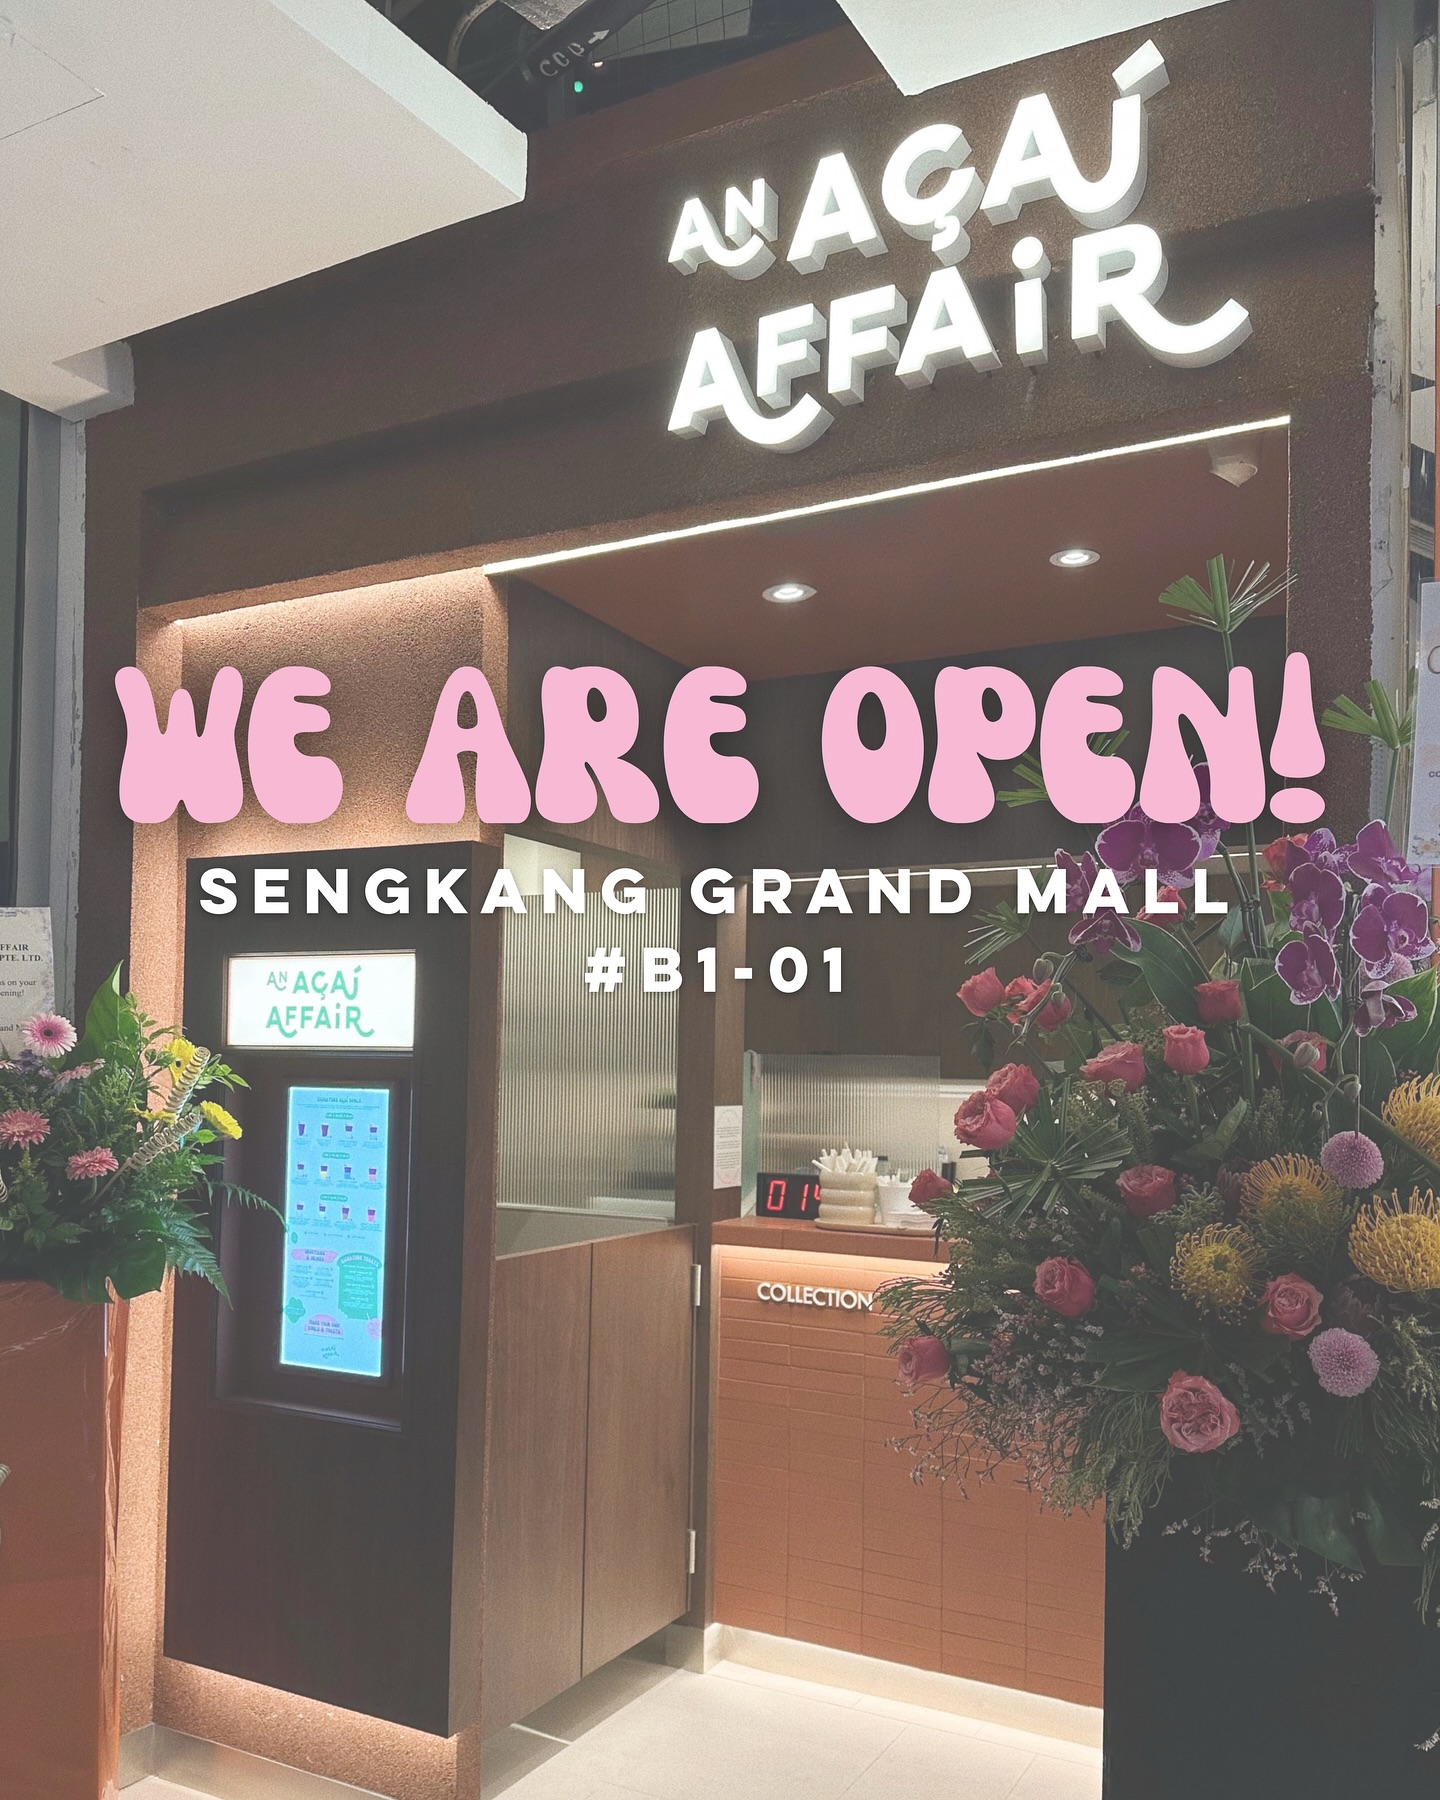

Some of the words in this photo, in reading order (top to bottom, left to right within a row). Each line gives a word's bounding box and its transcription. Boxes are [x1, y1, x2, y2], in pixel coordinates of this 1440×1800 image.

[668, 177, 778, 280] AN
[22, 954, 43, 962] LTD.
[266, 971, 288, 991] AN
[757, 1282, 873, 1311] COLLECTION
